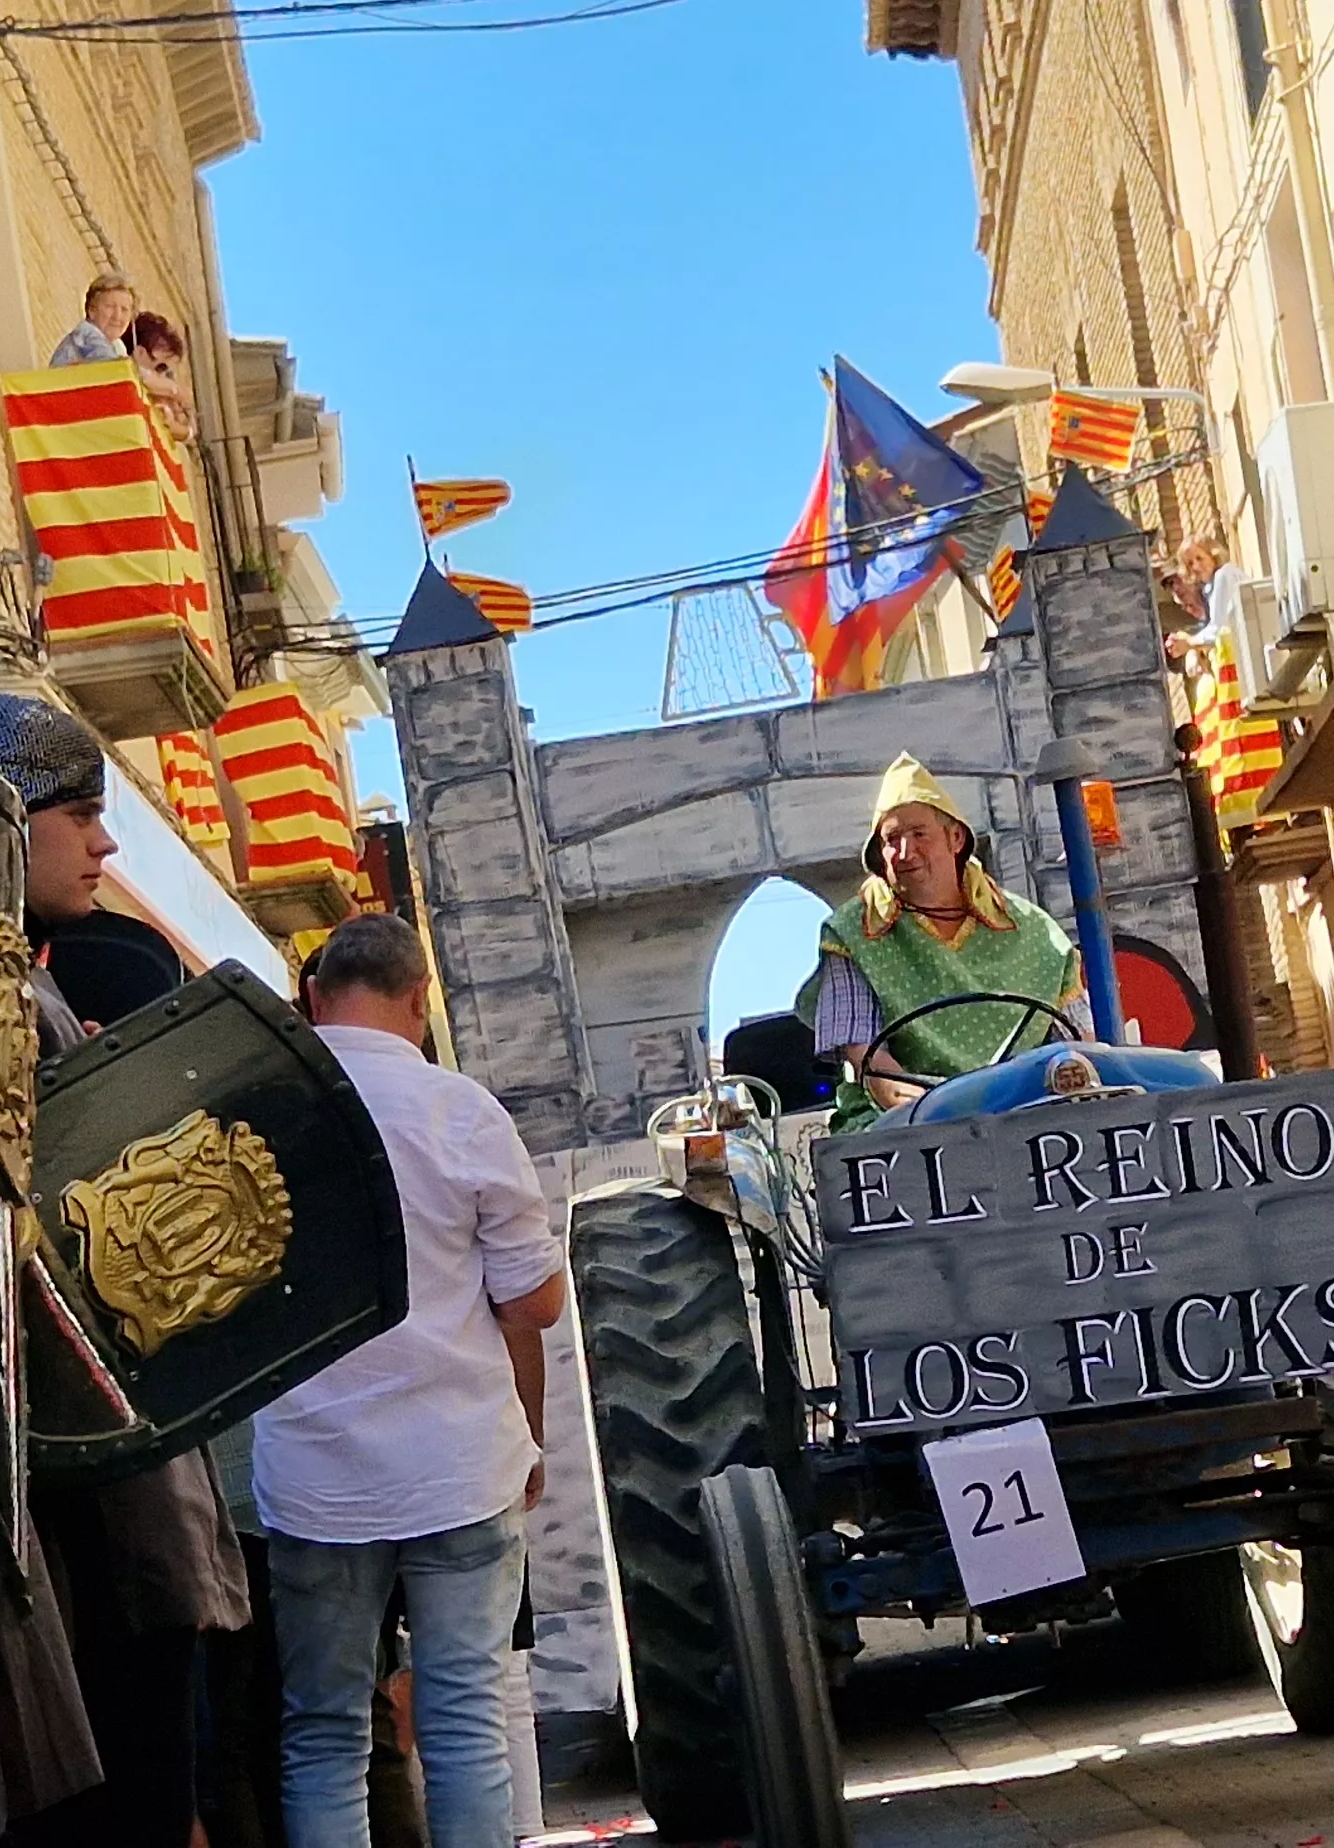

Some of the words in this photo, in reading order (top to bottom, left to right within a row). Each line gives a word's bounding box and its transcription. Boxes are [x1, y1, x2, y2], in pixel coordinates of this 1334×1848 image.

[839, 1145, 988, 1234] EL
[1060, 1221, 1158, 1285] DE
[848, 1330, 1030, 1428] LOS
[962, 1468, 1045, 1538] 21
